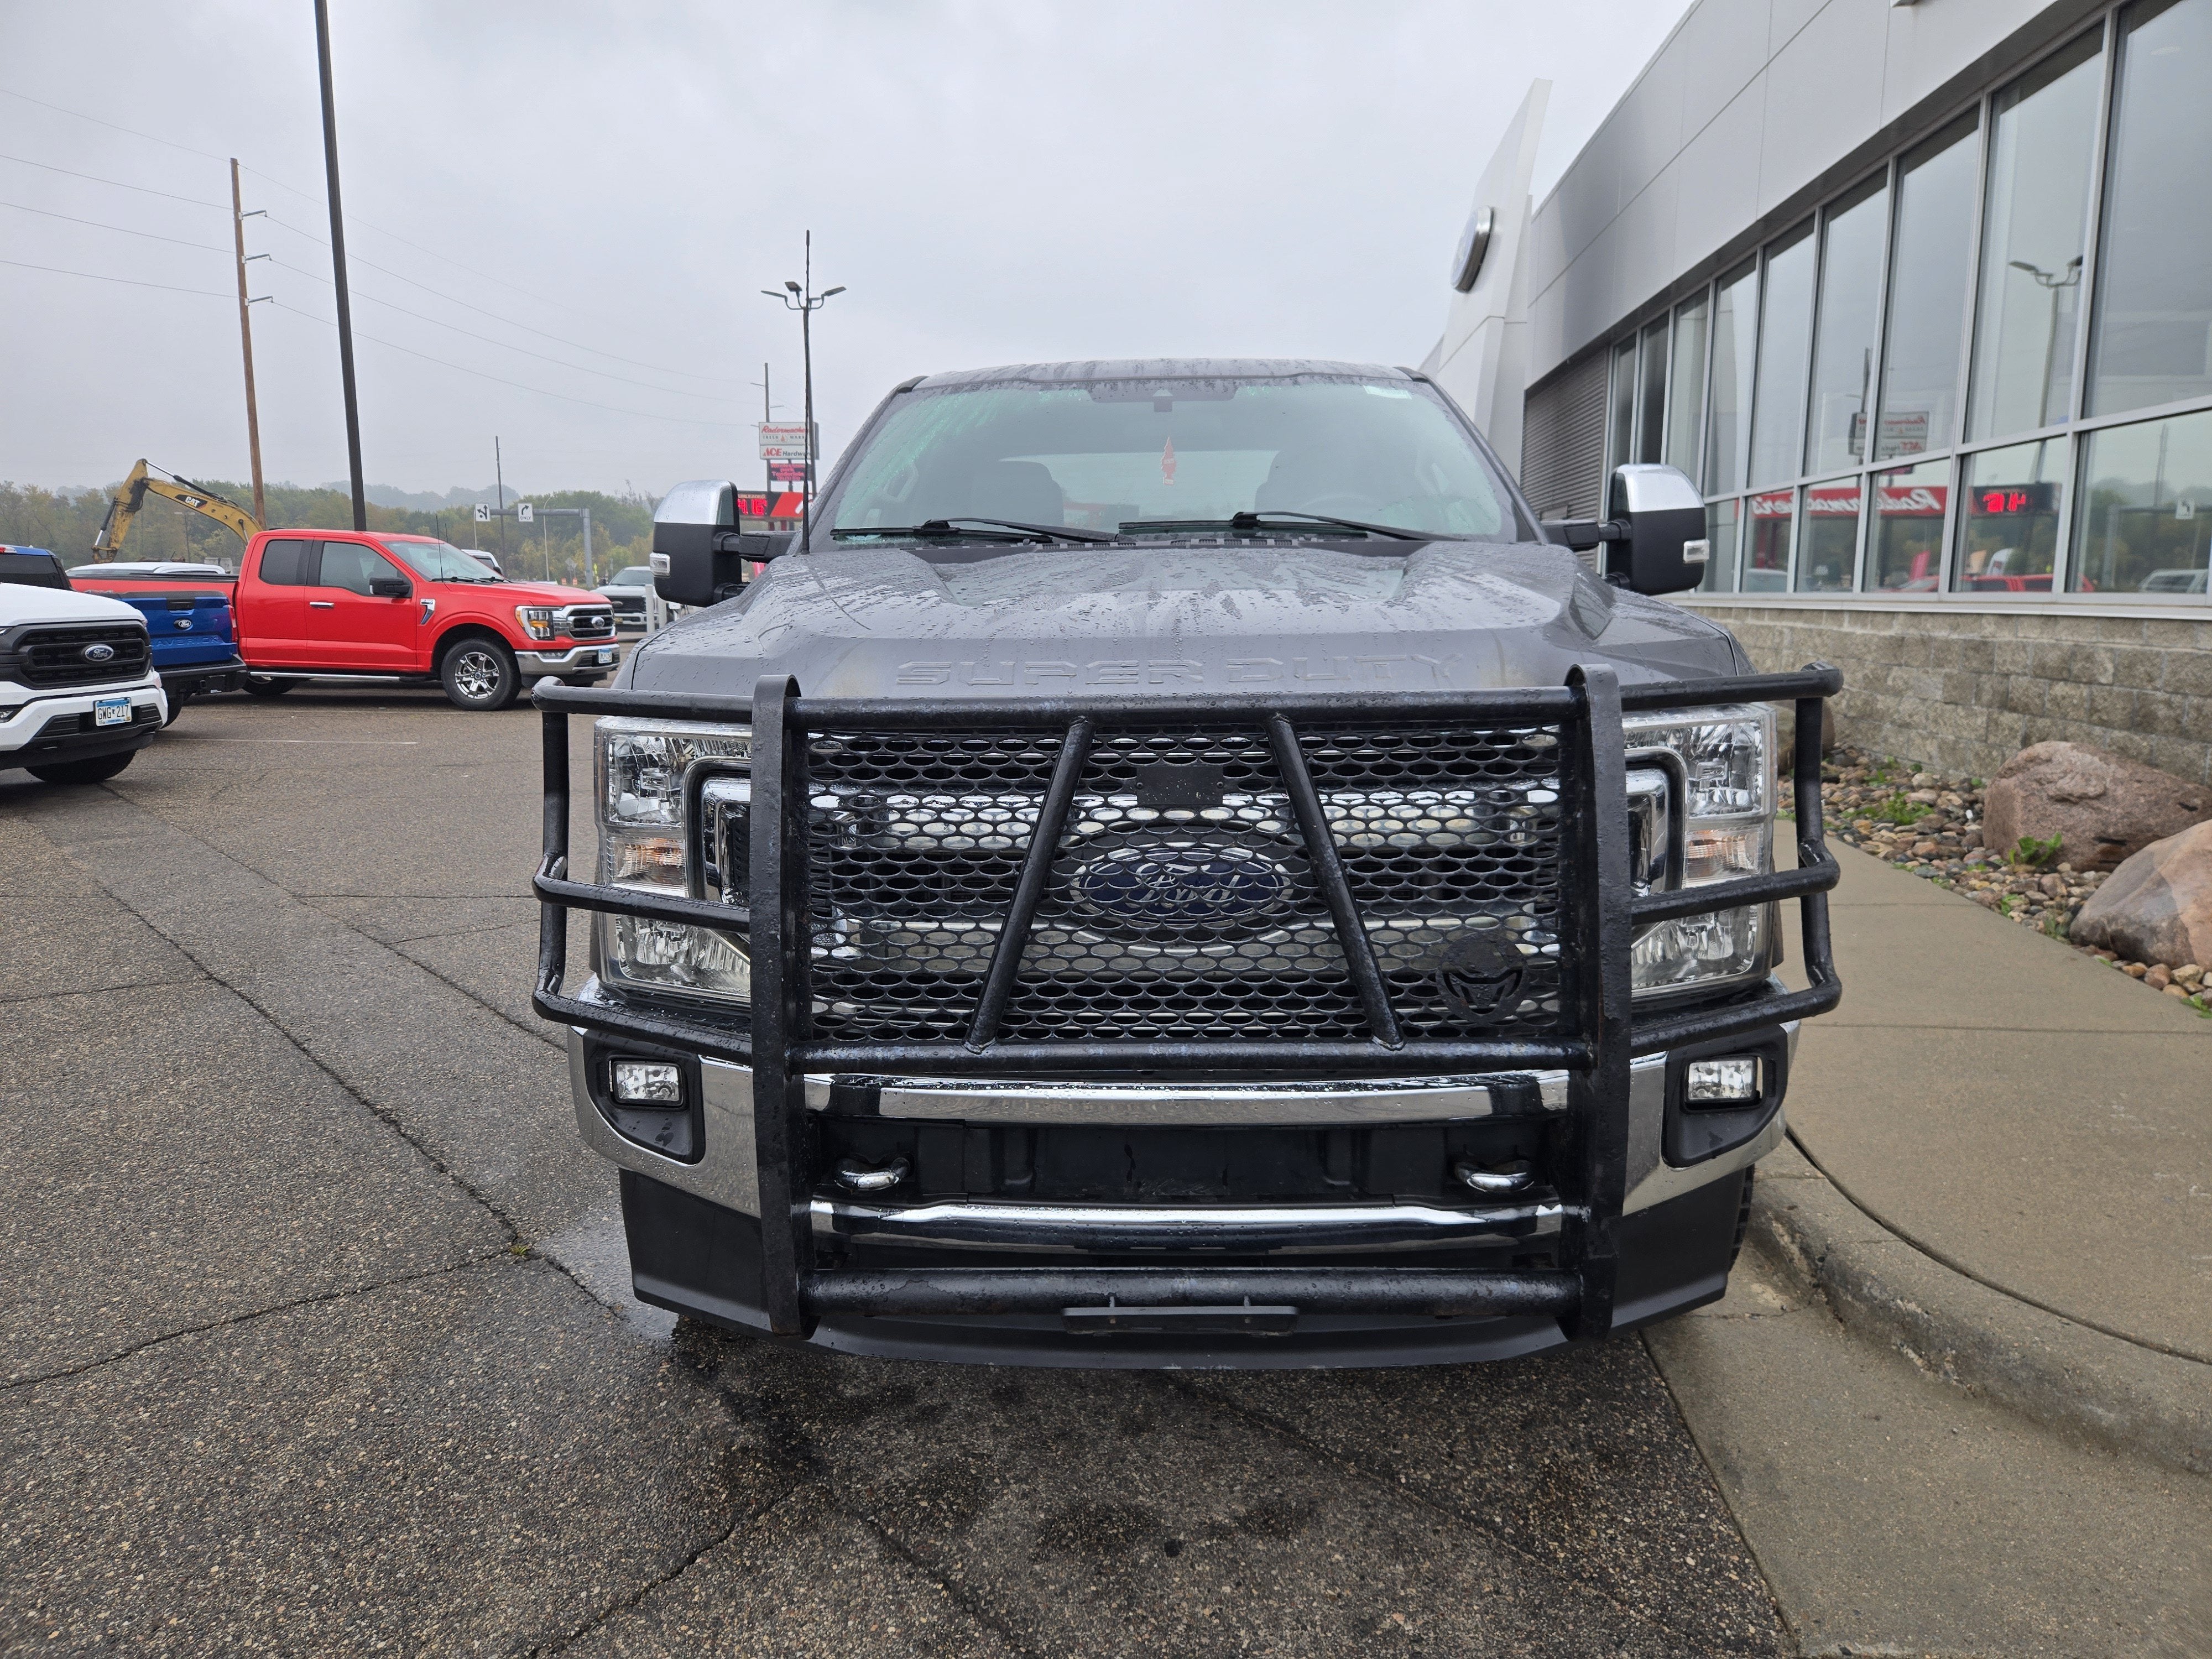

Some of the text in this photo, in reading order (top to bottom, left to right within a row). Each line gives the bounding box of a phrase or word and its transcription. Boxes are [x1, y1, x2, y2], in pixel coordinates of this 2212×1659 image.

[763, 447, 782, 456] ACE
[185, 496, 200, 507] CAT
[150, 637, 219, 647] AVERICK
[93, 649, 108, 658] Ford
[896, 654, 1463, 687] SUPER DUTY
[117, 705, 128, 717] 217
